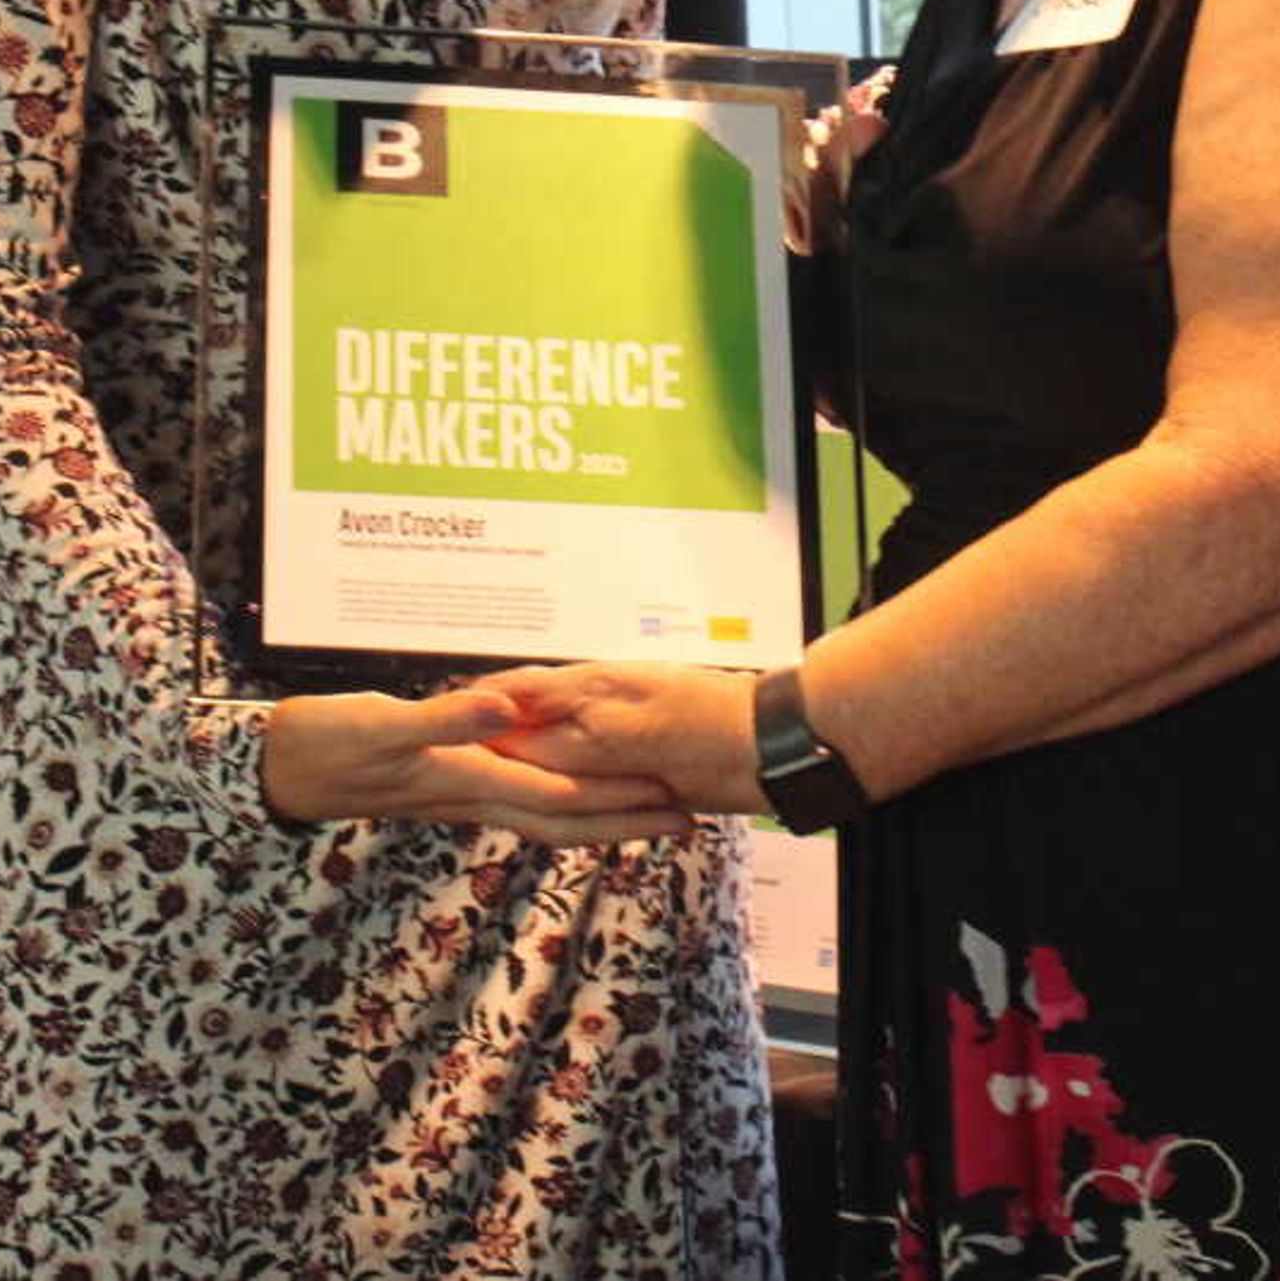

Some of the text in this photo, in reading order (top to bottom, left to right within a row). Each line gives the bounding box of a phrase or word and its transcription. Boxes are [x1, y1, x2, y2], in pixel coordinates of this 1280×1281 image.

[361, 117, 424, 180] B
[334, 325, 688, 410] DIFFERENCE
[335, 394, 573, 474] MAKERS
[339, 508, 488, 540] Avon Crocker
